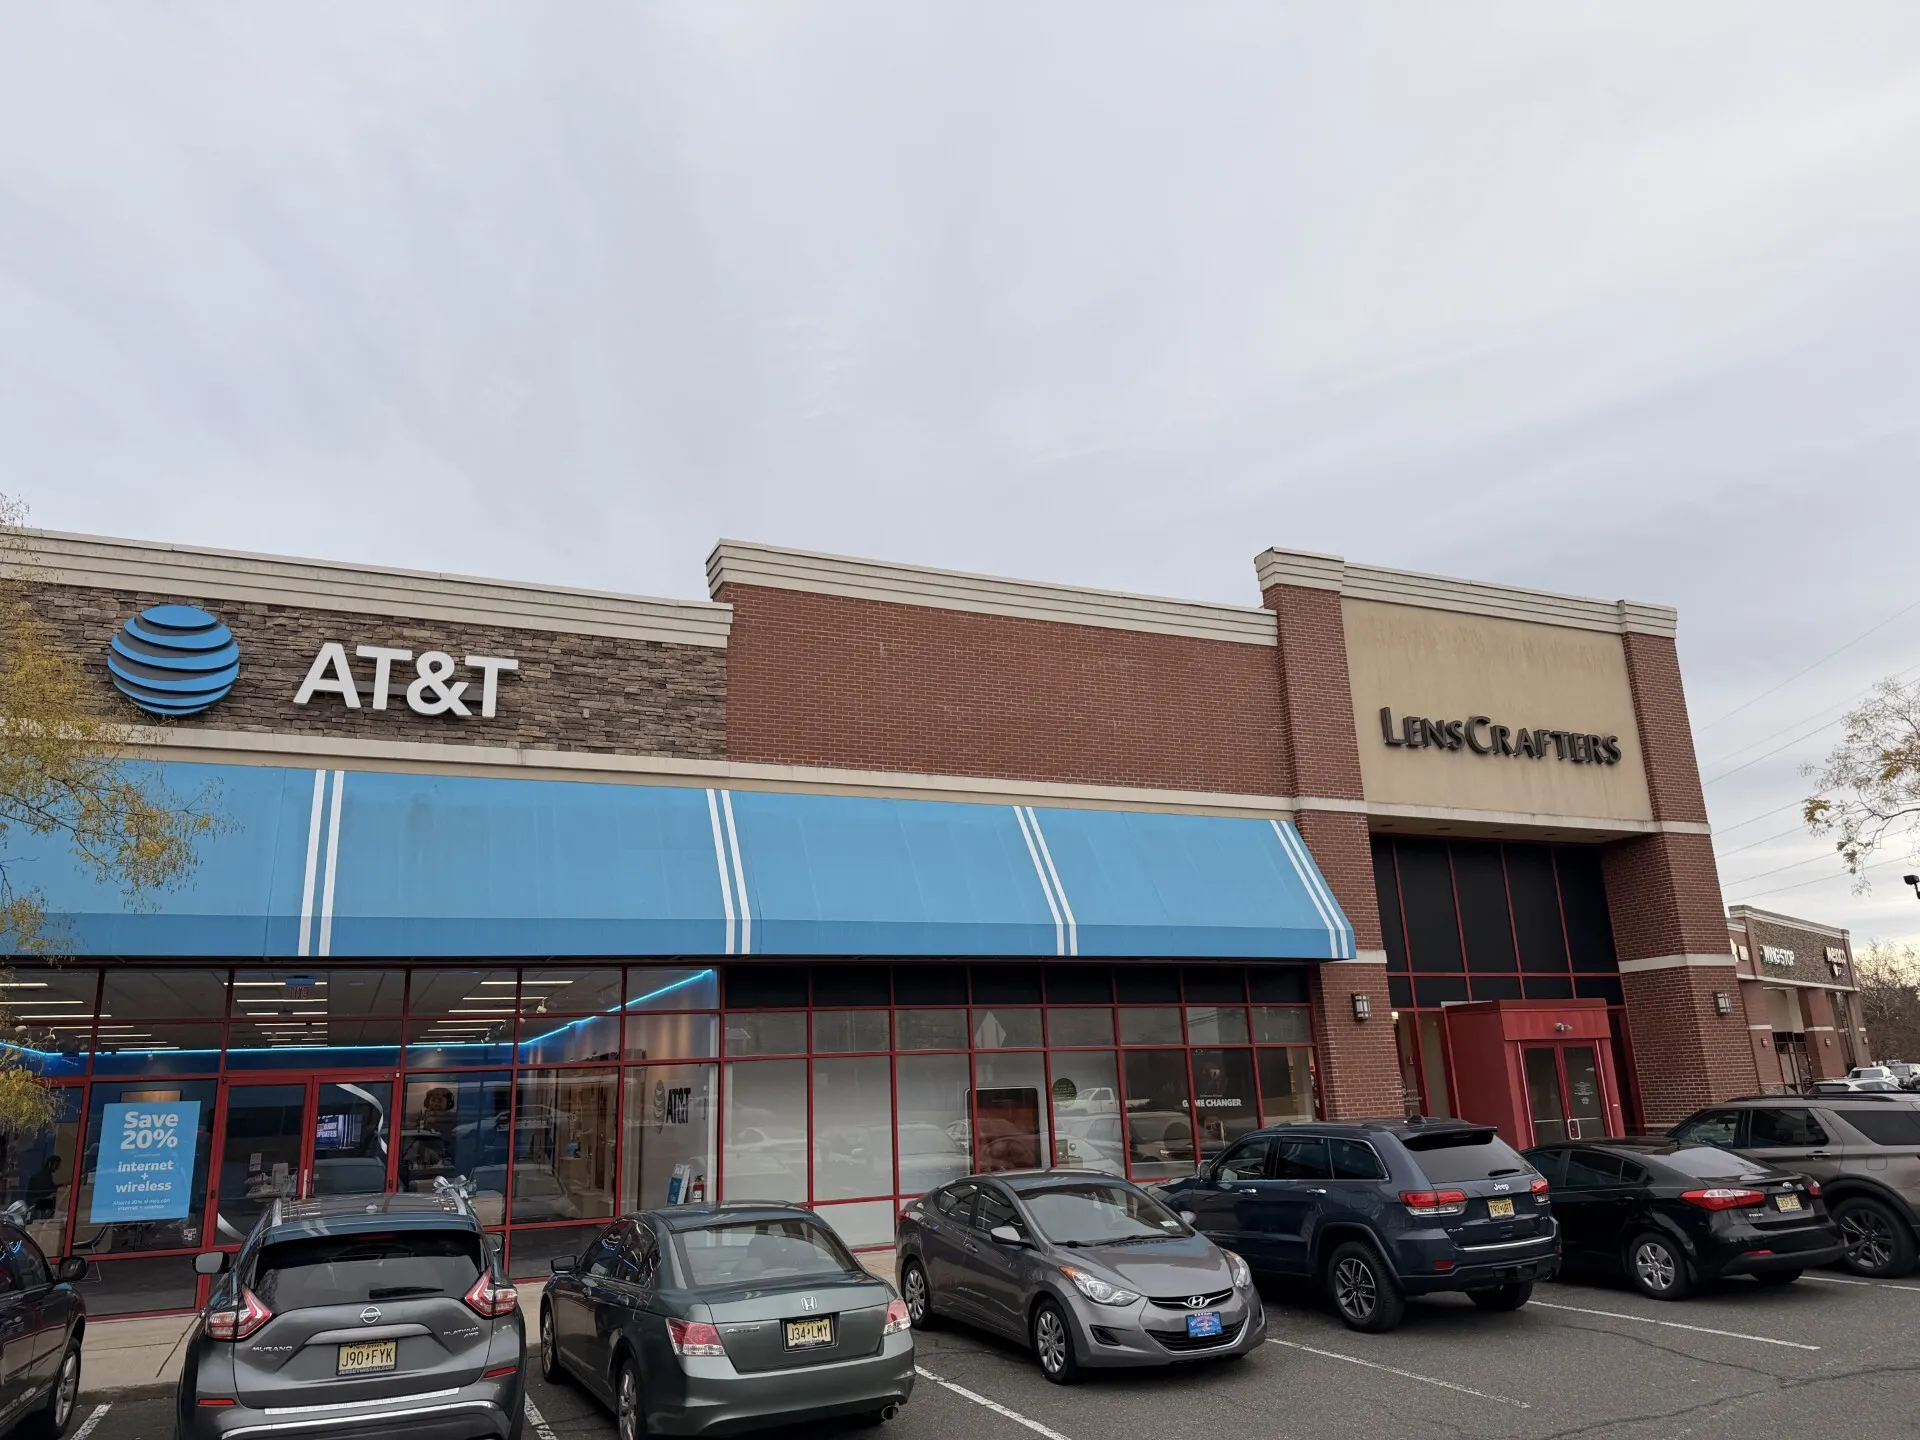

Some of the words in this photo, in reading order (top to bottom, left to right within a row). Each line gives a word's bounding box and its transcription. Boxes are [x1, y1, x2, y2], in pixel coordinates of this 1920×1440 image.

[293, 642, 519, 718] AT&T
[1380, 706, 1622, 765] LENSCRAFTERS
[1182, 1099, 1205, 1107] GME
[1206, 1098, 1242, 1107] CHANGER
[123, 1111, 179, 1129] Save
[120, 1128, 178, 1150] 20%
[117, 1160, 174, 1172] internet
[115, 1181, 172, 1193] wireless
[1493, 1183, 1510, 1191] Jeep
